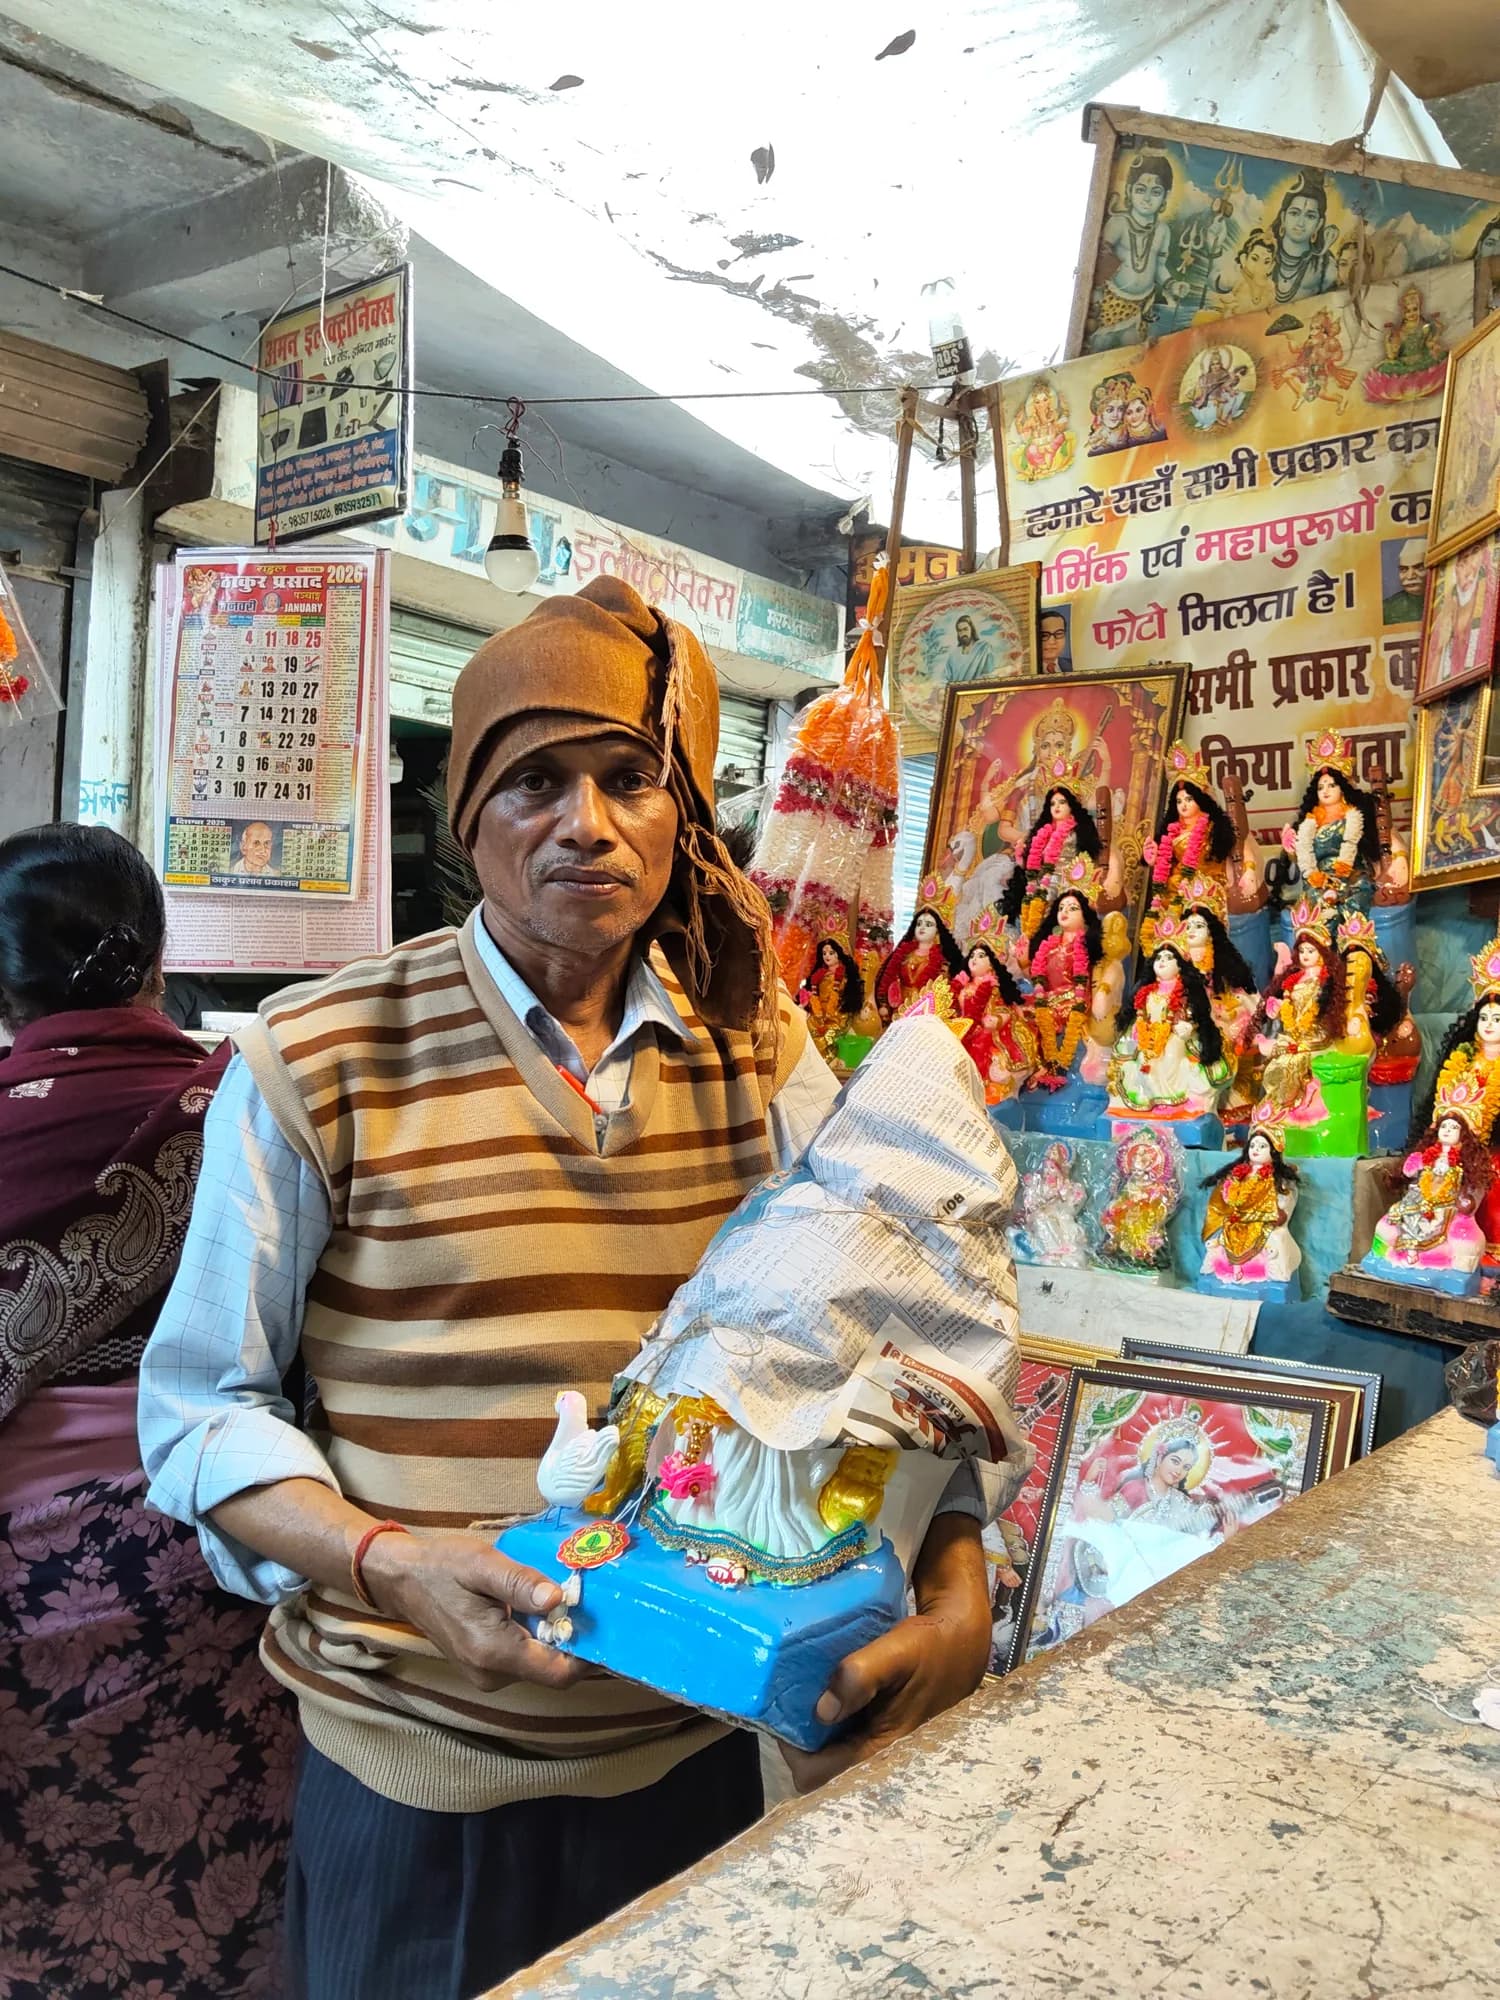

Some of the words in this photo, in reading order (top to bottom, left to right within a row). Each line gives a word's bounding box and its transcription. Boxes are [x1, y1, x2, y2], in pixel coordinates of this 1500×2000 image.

[265, 329, 301, 368] अमन
[304, 297, 396, 357] इलक्ट्रोनिक्स
[1026, 485, 1104, 538] हमारे
[1111, 463, 1177, 515] यहाँ
[1182, 447, 1259, 500] सभी
[1267, 429, 1380, 487] प्रकार
[1041, 545, 1130, 595] ार्मिक
[1140, 525, 1190, 578] एवं
[1195, 484, 1385, 568] महापुरूषों
[1389, 489, 1433, 524] क
[220, 575, 267, 593] ठाकुर
[272, 575, 322, 590] प्रसाद
[327, 565, 364, 584] 2026
[284, 602, 323, 613] JANUARY
[1091, 601, 1168, 650] फोटो
[1177, 592, 1299, 636] मिलता
[245, 630, 253, 645] 4
[265, 631, 278, 648] 11
[285, 630, 299, 646] 18
[305, 631, 321, 649] 25
[284, 656, 298, 673] 19
[1188, 648, 1257, 716] सभी
[1267, 644, 1372, 709] प्रकार
[1383, 638, 1421, 692] क
[261, 681, 275, 698] 13
[281, 681, 297, 696] 20
[302, 682, 319, 699] 27
[240, 705, 249, 723] 7
[259, 706, 273, 721] 14
[281, 707, 295, 724] 21
[301, 707, 318, 725] 28
[219, 730, 225, 744] 1
[238, 730, 247, 748] 8
[278, 732, 294, 749] 22
[300, 732, 316, 747] 29
[215, 755, 224, 769] 2
[236, 755, 245, 773] 9
[255, 756, 269, 771] 16
[297, 757, 313, 773] 30
[1199, 733, 1295, 792] किया
[1305, 729, 1407, 783] ाता
[214, 779, 222, 794] 3
[232, 780, 246, 798] 10
[254, 781, 268, 799] 17
[274, 782, 290, 800] 24
[296, 783, 311, 801] 31
[211, 876, 236, 887] ठाकुर
[901, 1369, 967, 1422] हिन्दुस्तान
